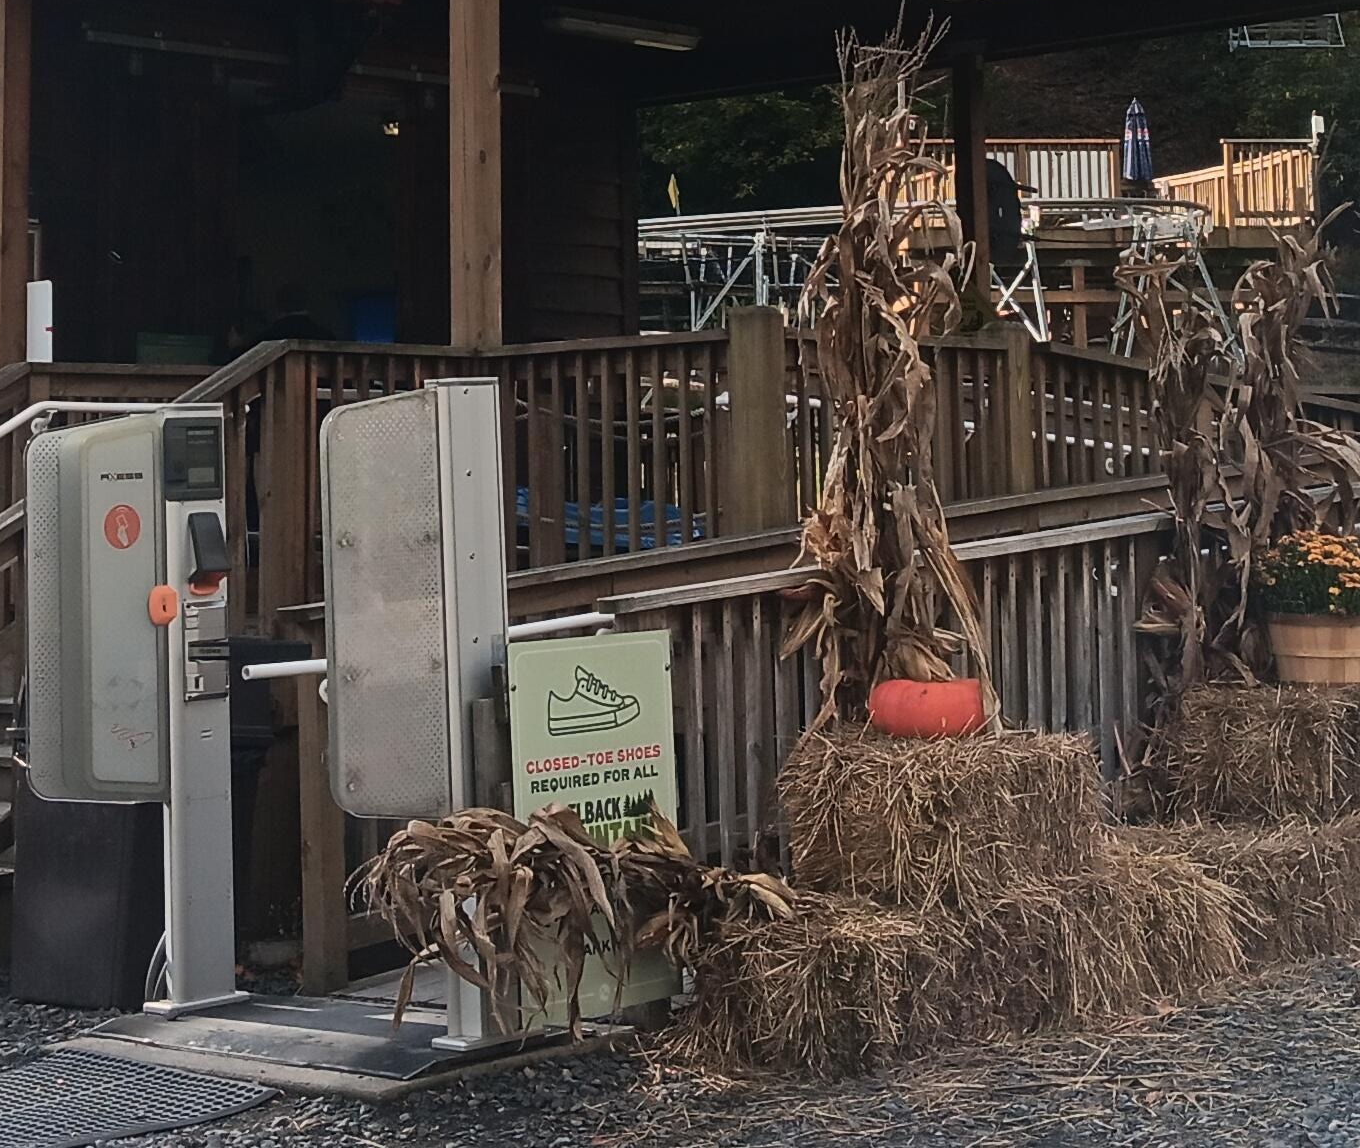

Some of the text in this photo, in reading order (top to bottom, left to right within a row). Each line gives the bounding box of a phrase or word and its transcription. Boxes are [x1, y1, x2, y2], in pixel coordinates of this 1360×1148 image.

[526, 744, 661, 774] CLOSED-TOE SHOES
[530, 764, 659, 794] REQUIRED FOR ALL
